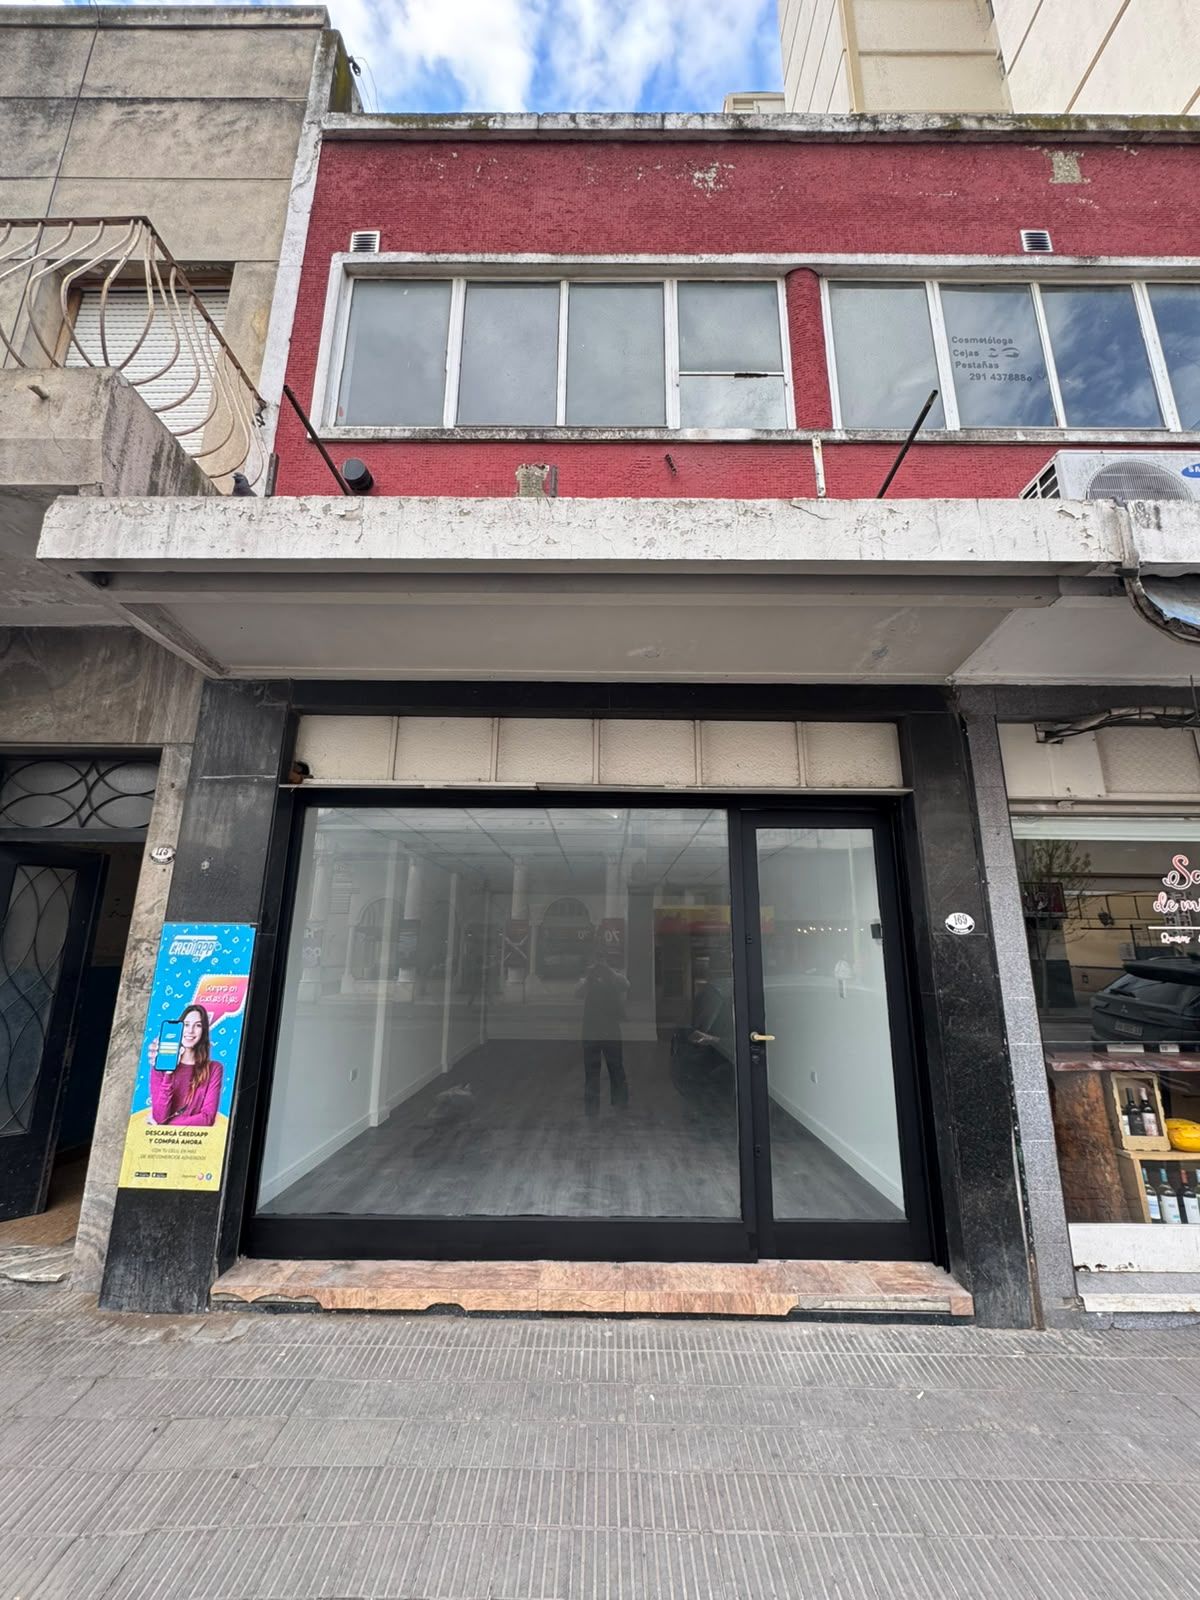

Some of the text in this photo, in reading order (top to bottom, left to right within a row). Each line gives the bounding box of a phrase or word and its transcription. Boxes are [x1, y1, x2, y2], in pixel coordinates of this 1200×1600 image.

[952, 336, 1013, 345] Cosmetóloga
[953, 349, 979, 358] Cejas
[955, 361, 999, 369] Pestañas
[1153, 891, 1179, 913] de
[954, 914, 968, 926] 169
